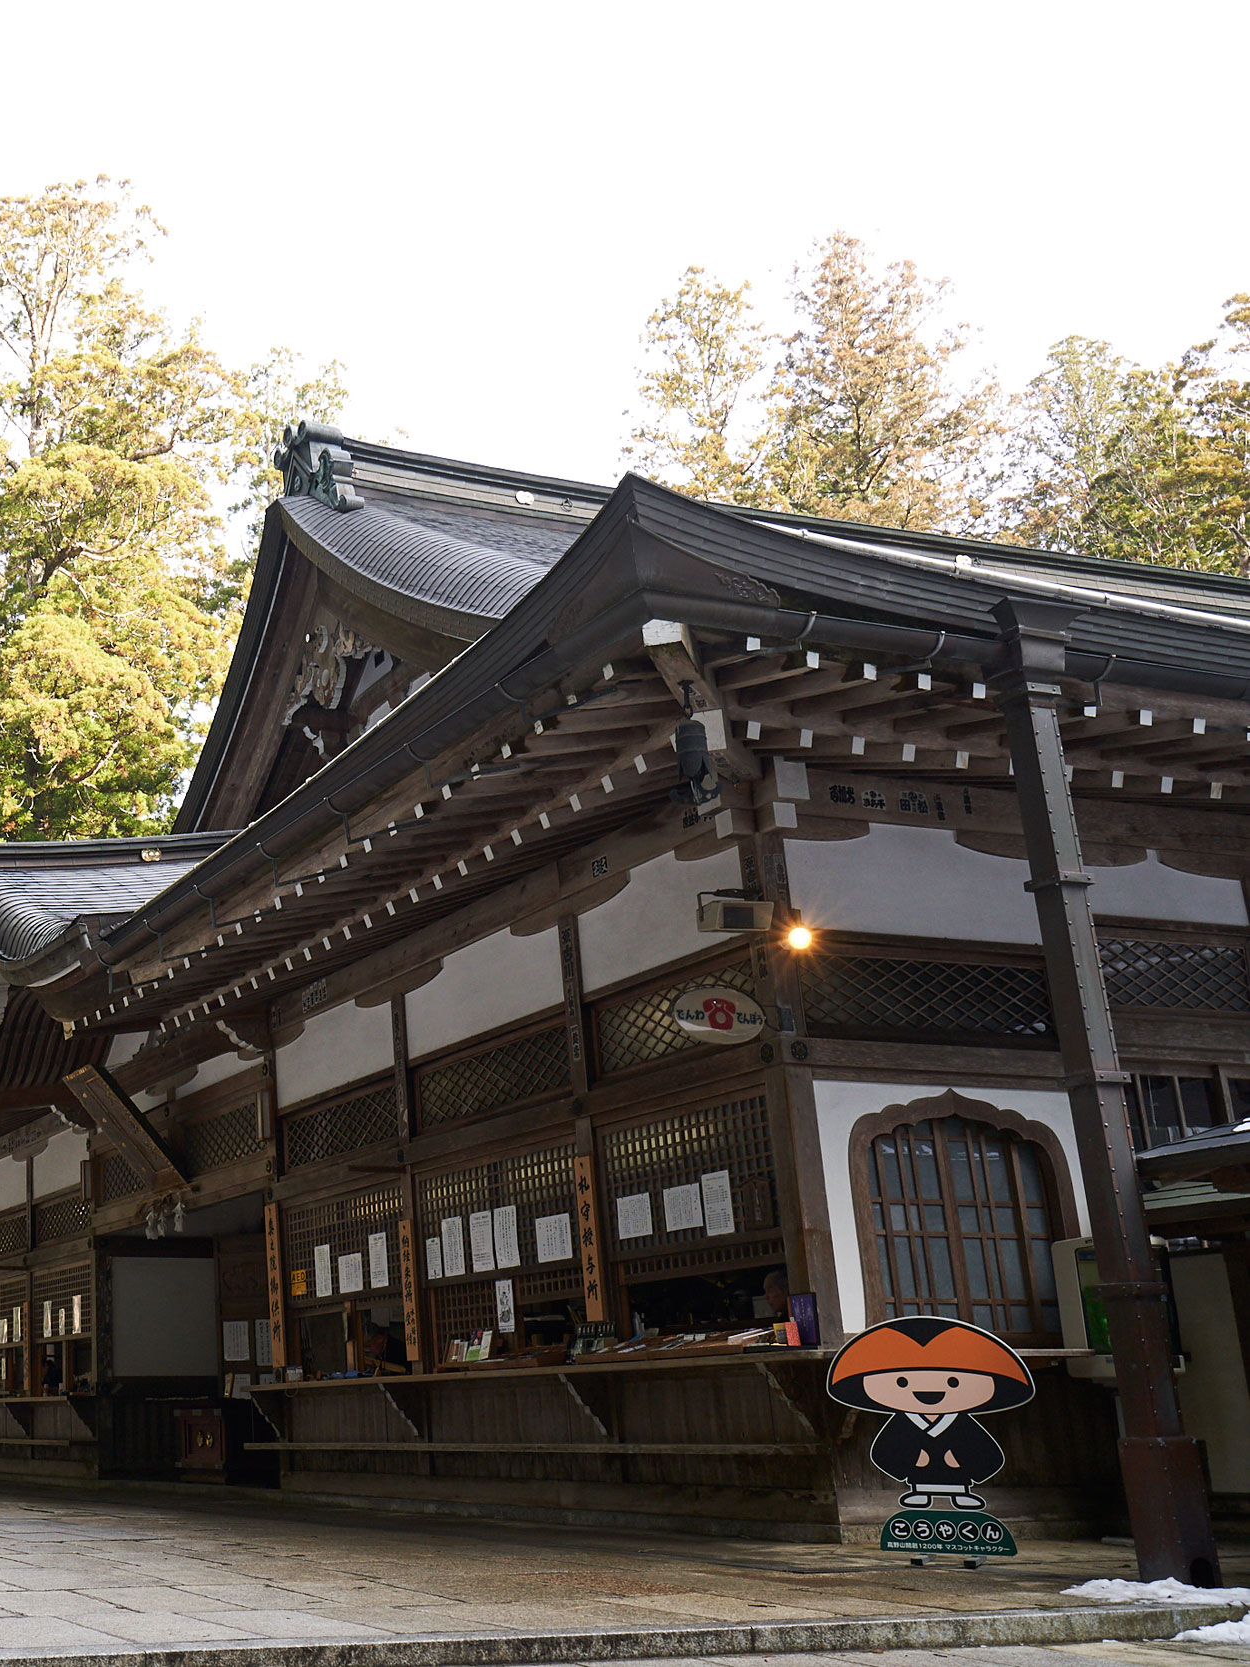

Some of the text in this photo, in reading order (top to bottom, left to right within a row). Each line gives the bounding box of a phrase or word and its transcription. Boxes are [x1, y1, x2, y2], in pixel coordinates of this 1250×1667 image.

[676, 1009, 705, 1020] でんわ
[291, 1271, 306, 1281] AED
[892, 1521, 1002, 1541] こうやくん
[945, 1544, 1010, 1552] マスコットキャラクター
